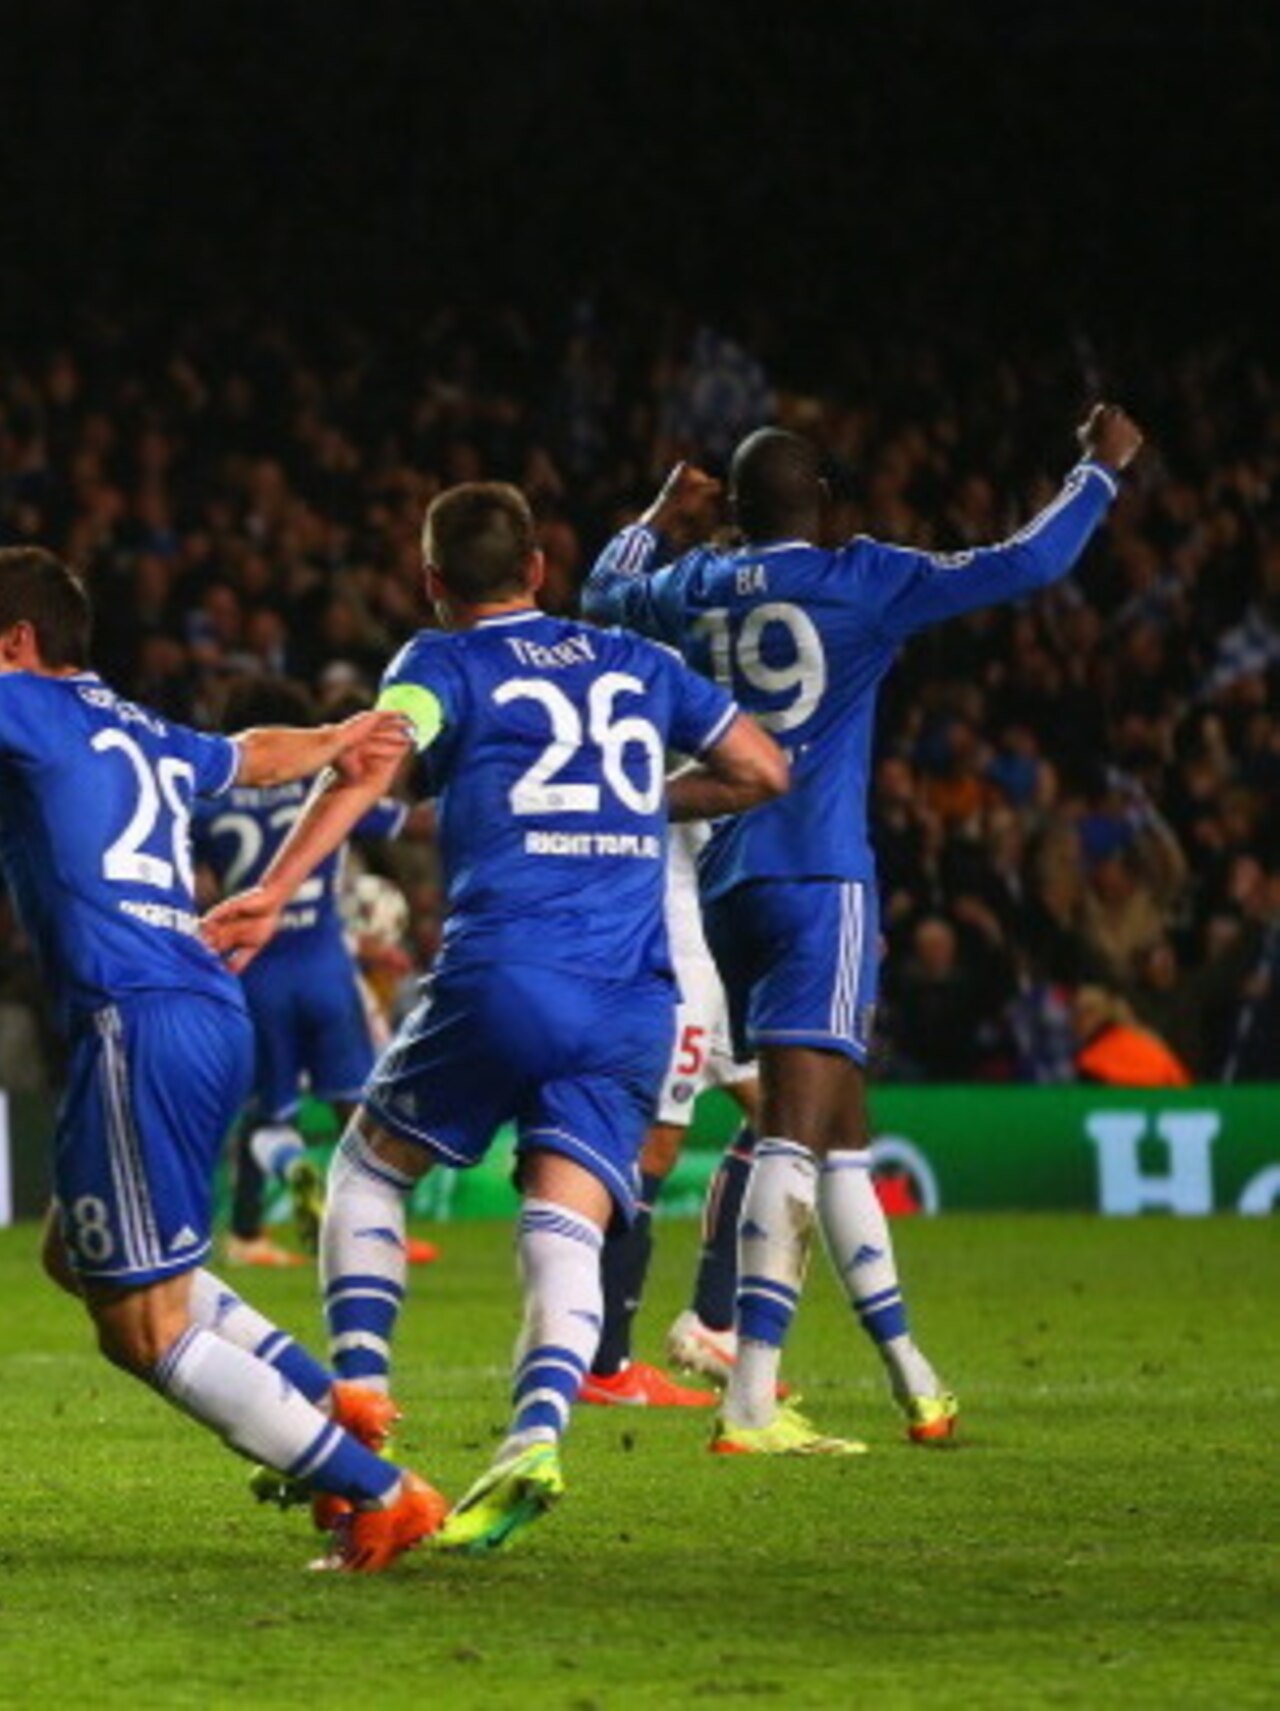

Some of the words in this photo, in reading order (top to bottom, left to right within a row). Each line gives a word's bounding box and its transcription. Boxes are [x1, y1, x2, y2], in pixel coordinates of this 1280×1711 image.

[735, 564, 768, 597] BA
[692, 602, 826, 733] 19
[491, 671, 664, 815] 26
[677, 1025, 705, 1076] 5
[72, 1194, 114, 1262] 8
